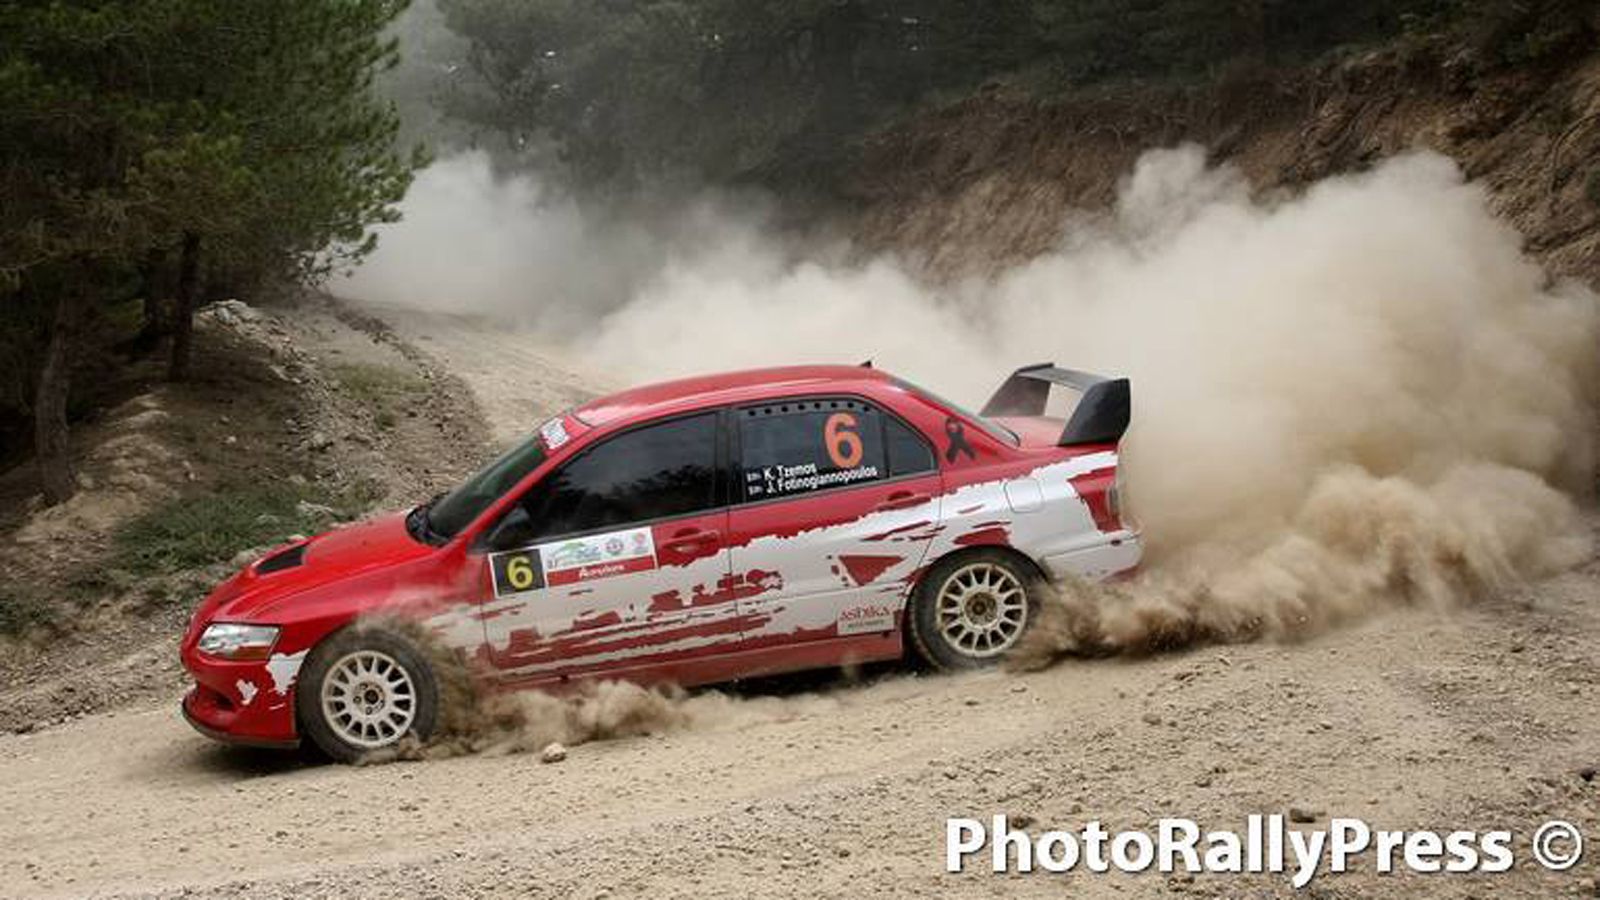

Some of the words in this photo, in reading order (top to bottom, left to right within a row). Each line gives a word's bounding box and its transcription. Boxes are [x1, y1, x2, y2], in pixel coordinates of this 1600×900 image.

[824, 411, 863, 469] 6
[764, 470, 775, 481] K.
[777, 463, 817, 477] Tzemos
[766, 480, 775, 493] J.
[778, 466, 878, 490] Fotinogiannopoulos
[508, 555, 534, 590] 6
